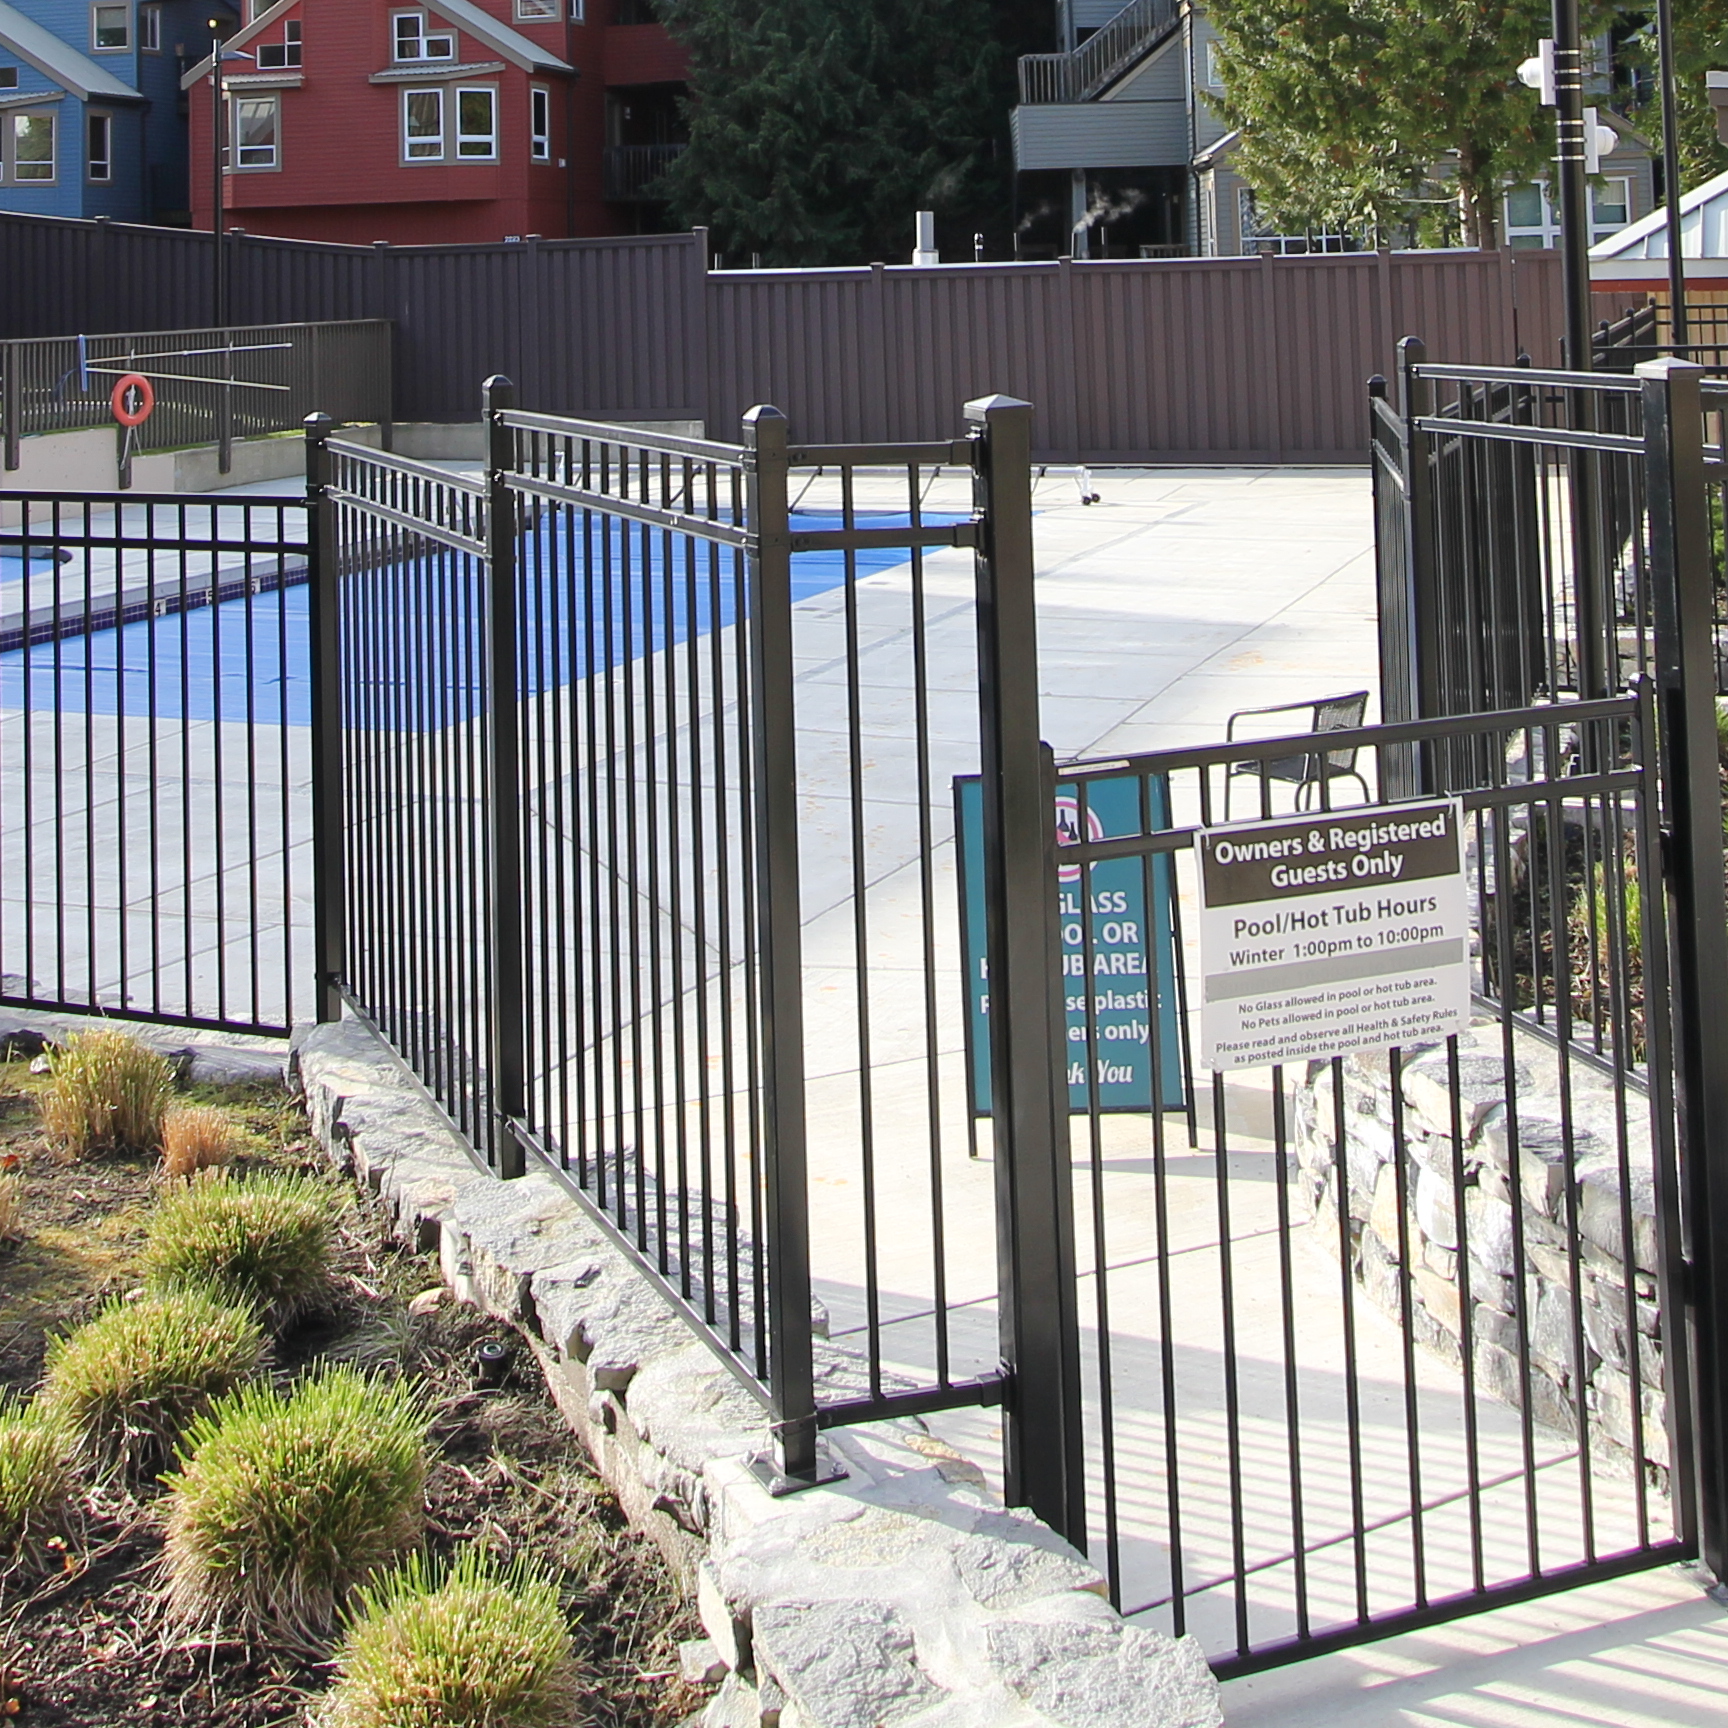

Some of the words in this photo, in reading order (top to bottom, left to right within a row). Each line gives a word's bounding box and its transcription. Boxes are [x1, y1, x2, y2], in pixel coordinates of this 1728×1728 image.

[1215, 837, 1303, 865] Owners
[1308, 830, 1325, 852] &
[1330, 814, 1446, 852] Registered
[1271, 860, 1347, 888] Guests
[1351, 851, 1403, 877] Only
[1103, 922, 1139, 944] OR
[1234, 909, 1328, 939] Pool/Hot
[1333, 902, 1371, 923] Tub
[1378, 896, 1437, 919] Hours
[1229, 946, 1285, 966] Winter
[1293, 940, 1353, 958] 1:00pm
[1357, 934, 1373, 949] to
[1377, 925, 1444, 946] 10:00pm
[1238, 1003, 1254, 1014] No
[1256, 1000, 1283, 1012] Glass
[1284, 993, 1325, 1008] allowed
[1327, 991, 1336, 1001] in
[1338, 987, 1361, 1002] pool
[1363, 987, 1374, 996] or
[1376, 983, 1392, 994] hot
[1394, 980, 1411, 991] tub
[1413, 977, 1437, 988] area.
[1241, 1020, 1256, 1031] No
[1259, 1016, 1280, 1027] Pets
[1282, 1010, 1322, 1023] allowed
[1325, 1008, 1334, 1018] in
[1336, 1004, 1359, 1021] pool
[1361, 1004, 1372, 1013] or
[1374, 1000, 1391, 1012] hot
[1392, 997, 1409, 1008] tub
[1412, 994, 1436, 1005] area.
[1104, 1019, 1150, 1045] only
[1216, 1040, 1250, 1053] Please
[1252, 1036, 1276, 1048] read
[1278, 1033, 1297, 1045] and
[1299, 1028, 1340, 1042] observe
[1342, 1024, 1354, 1035] all
[1356, 1019, 1389, 1034] Health
[1391, 1018, 1398, 1028] &
[1401, 1012, 1431, 1028] Safety
[1433, 1007, 1458, 1020] Rules
[1234, 1054, 1246, 1064] as
[1248, 1047, 1284, 1064] posted
[1286, 1043, 1317, 1057] inside
[1319, 1040, 1336, 1051] the
[1338, 1037, 1360, 1053] pool
[1362, 1033, 1381, 1046] and
[1384, 1030, 1400, 1042] hot
[1402, 1027, 1419, 1039] tub
[1421, 1025, 1444, 1036] area.
[1097, 1059, 1134, 1084] You
